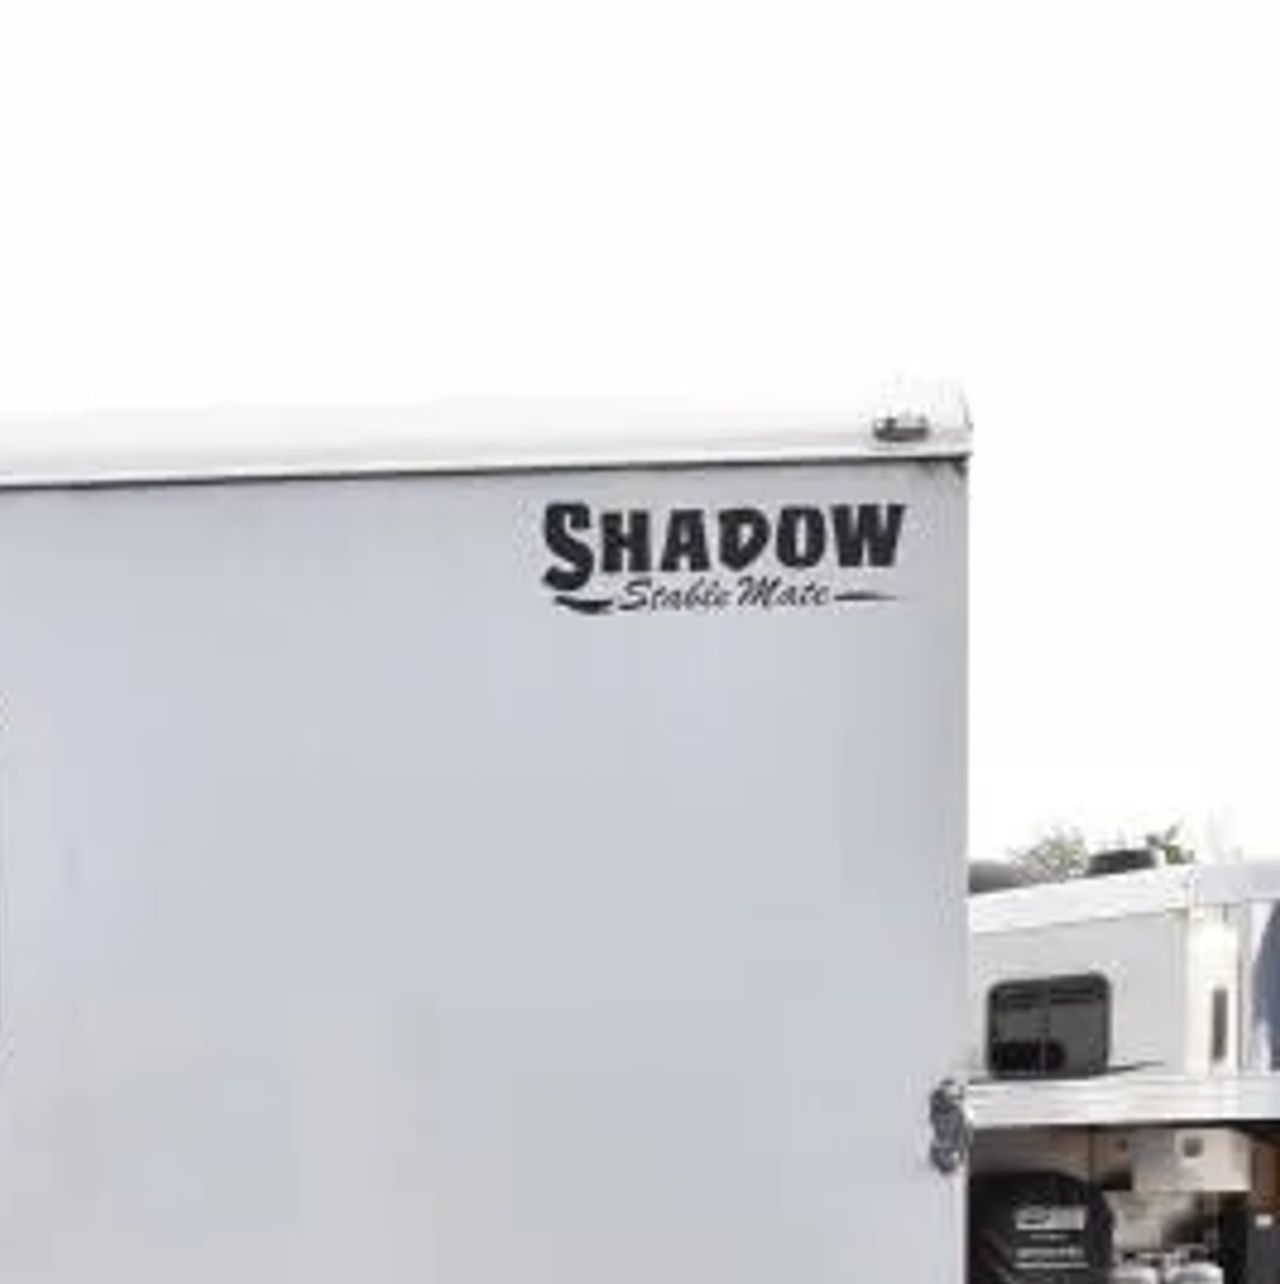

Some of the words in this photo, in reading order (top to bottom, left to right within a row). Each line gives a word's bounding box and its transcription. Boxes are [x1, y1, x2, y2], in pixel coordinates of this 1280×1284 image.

[543, 503, 906, 592] SHADOW
[618, 577, 733, 611] Stable
[737, 576, 830, 608] Mate
